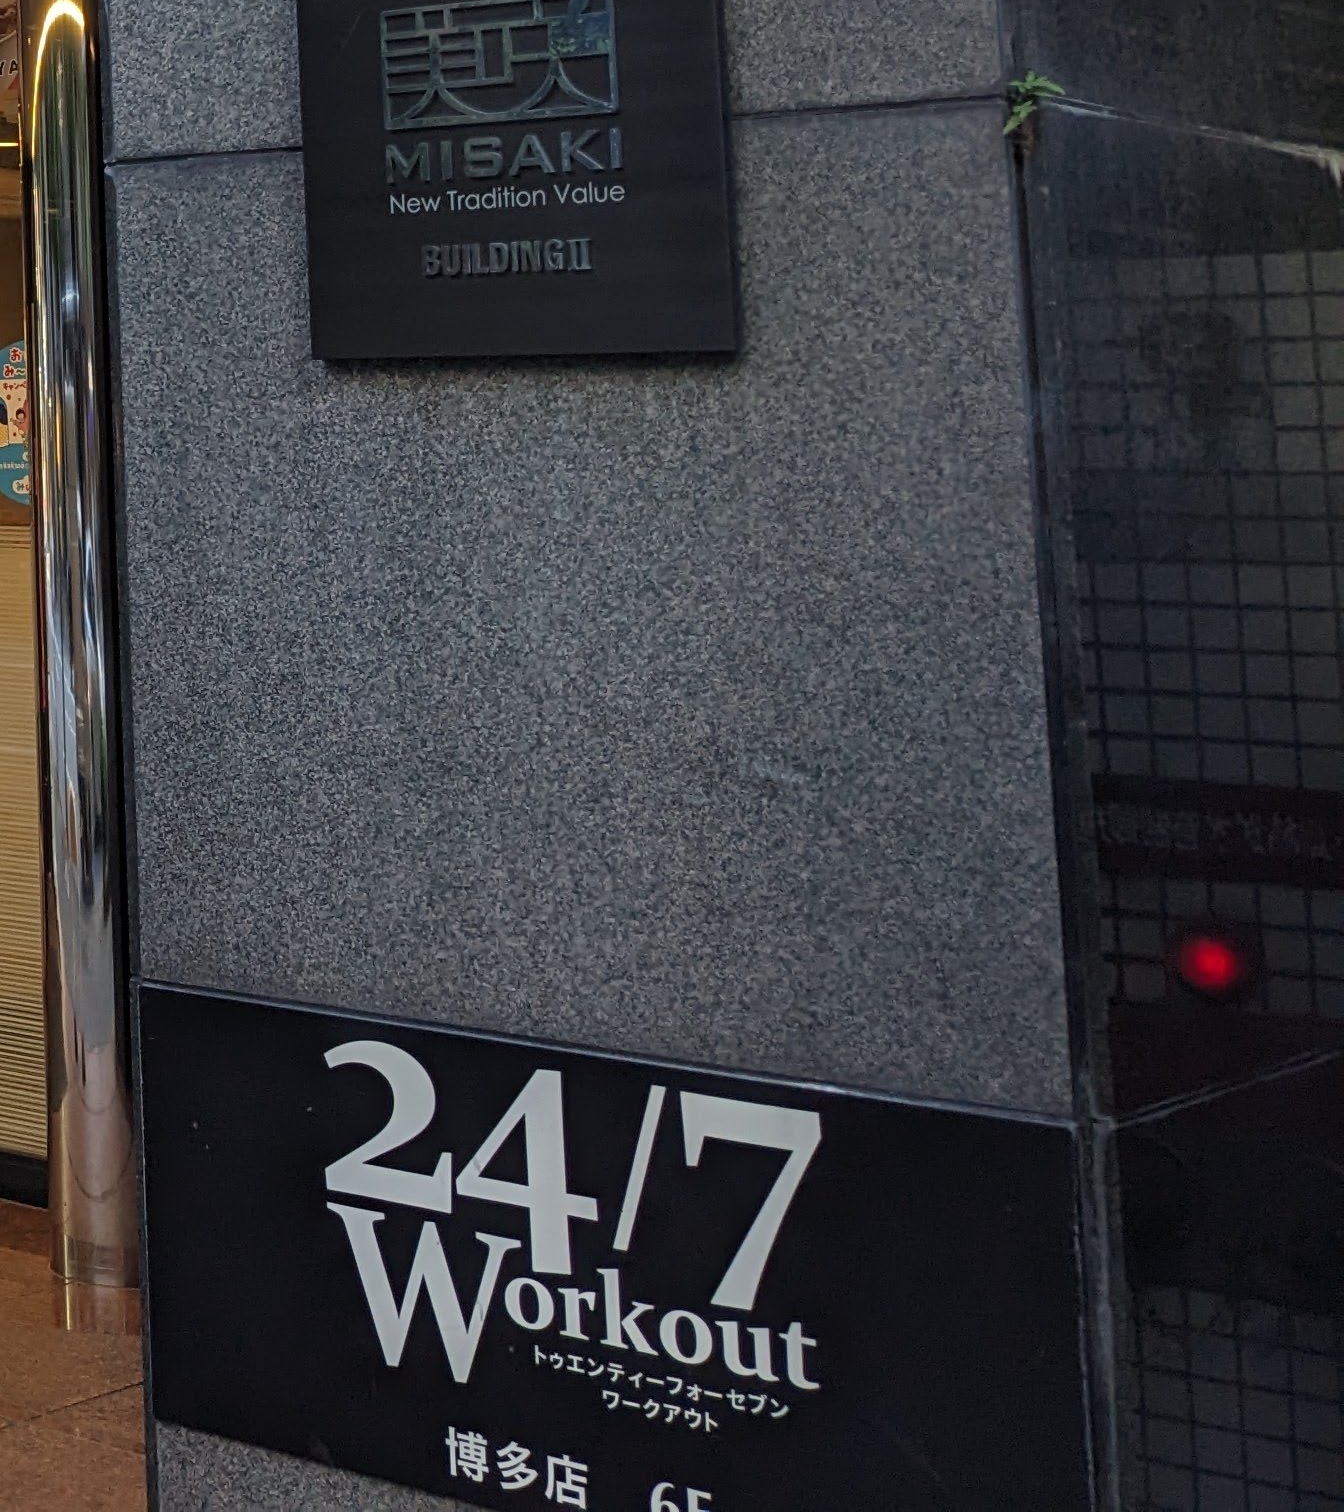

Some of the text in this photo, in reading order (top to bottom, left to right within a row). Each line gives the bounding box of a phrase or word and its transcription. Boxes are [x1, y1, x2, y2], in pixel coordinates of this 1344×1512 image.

[384, 126, 625, 184] MISAKI
[389, 181, 626, 215] New Tradition Value
[323, 1040, 823, 1311] 24/7
[326, 1201, 822, 1390] Workout
[532, 1344, 790, 1419] トゥエンティーフォーセブン
[601, 1388, 719, 1433] ワークアウト
[444, 1426, 589, 1511] 博多店
